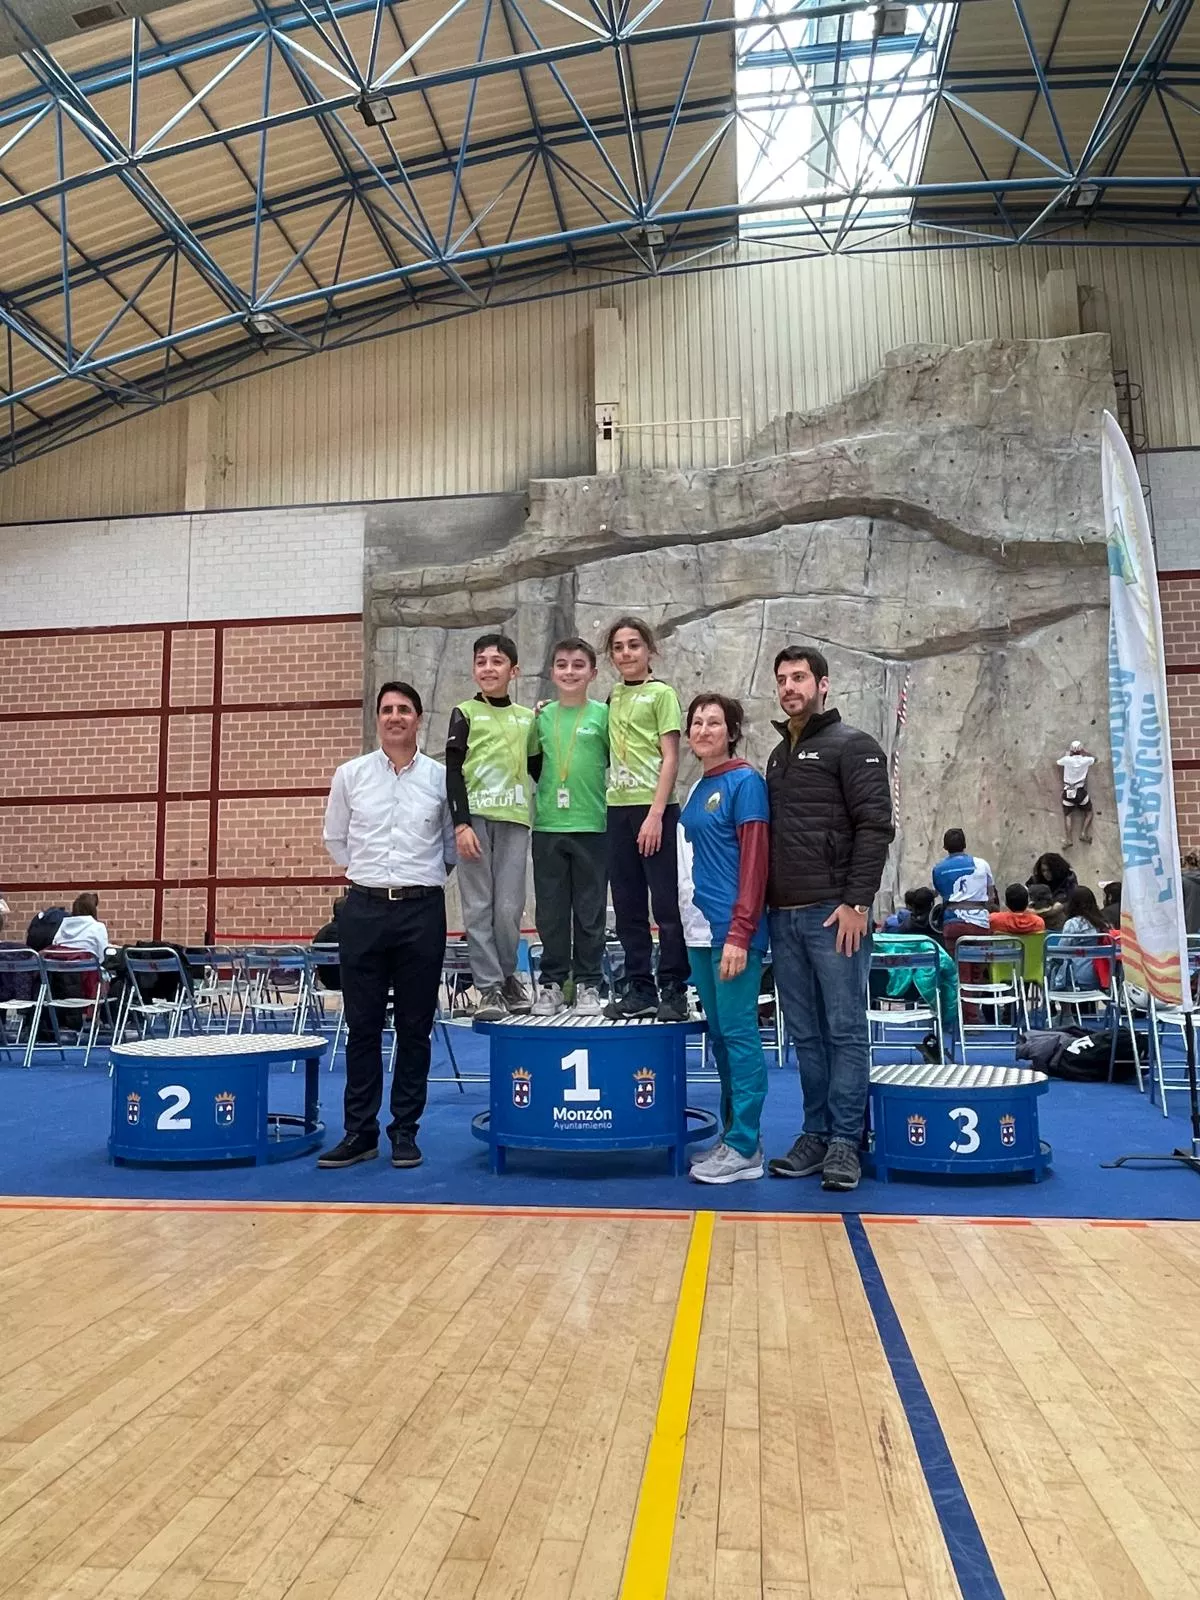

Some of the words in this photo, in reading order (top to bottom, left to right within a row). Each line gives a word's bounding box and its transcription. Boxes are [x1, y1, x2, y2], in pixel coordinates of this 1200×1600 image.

[561, 1049, 601, 1101] 1
[157, 1085, 191, 1130] 2
[553, 1106, 612, 1121] Monzón
[553, 1121, 613, 1131] Ayuntamiento
[949, 1107, 980, 1154] 3
